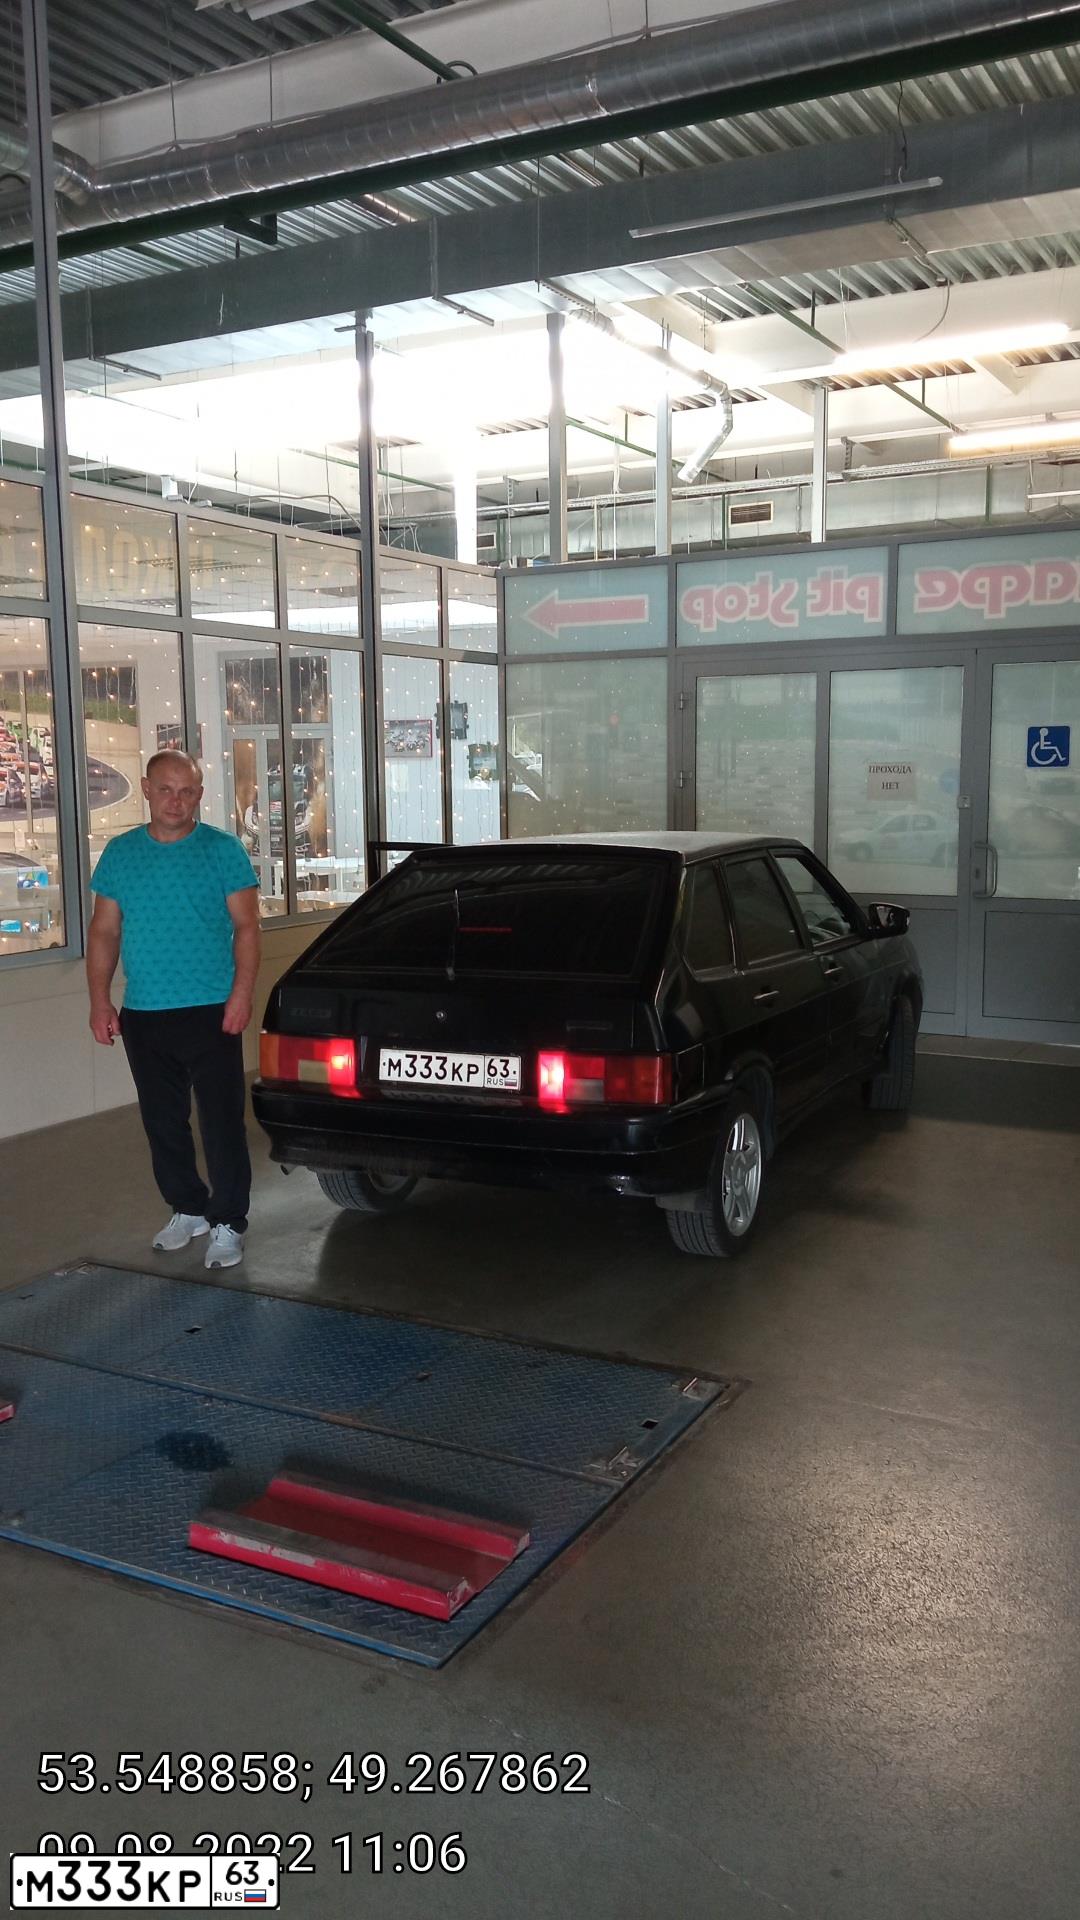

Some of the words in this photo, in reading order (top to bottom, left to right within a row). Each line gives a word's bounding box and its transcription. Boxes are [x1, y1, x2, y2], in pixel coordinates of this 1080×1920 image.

[868, 765, 912, 775] ПРОХОДА
[881, 781, 900, 790] НЕТ
[487, 1058, 510, 1078] 63
[486, 1078, 504, 1086] RUS
